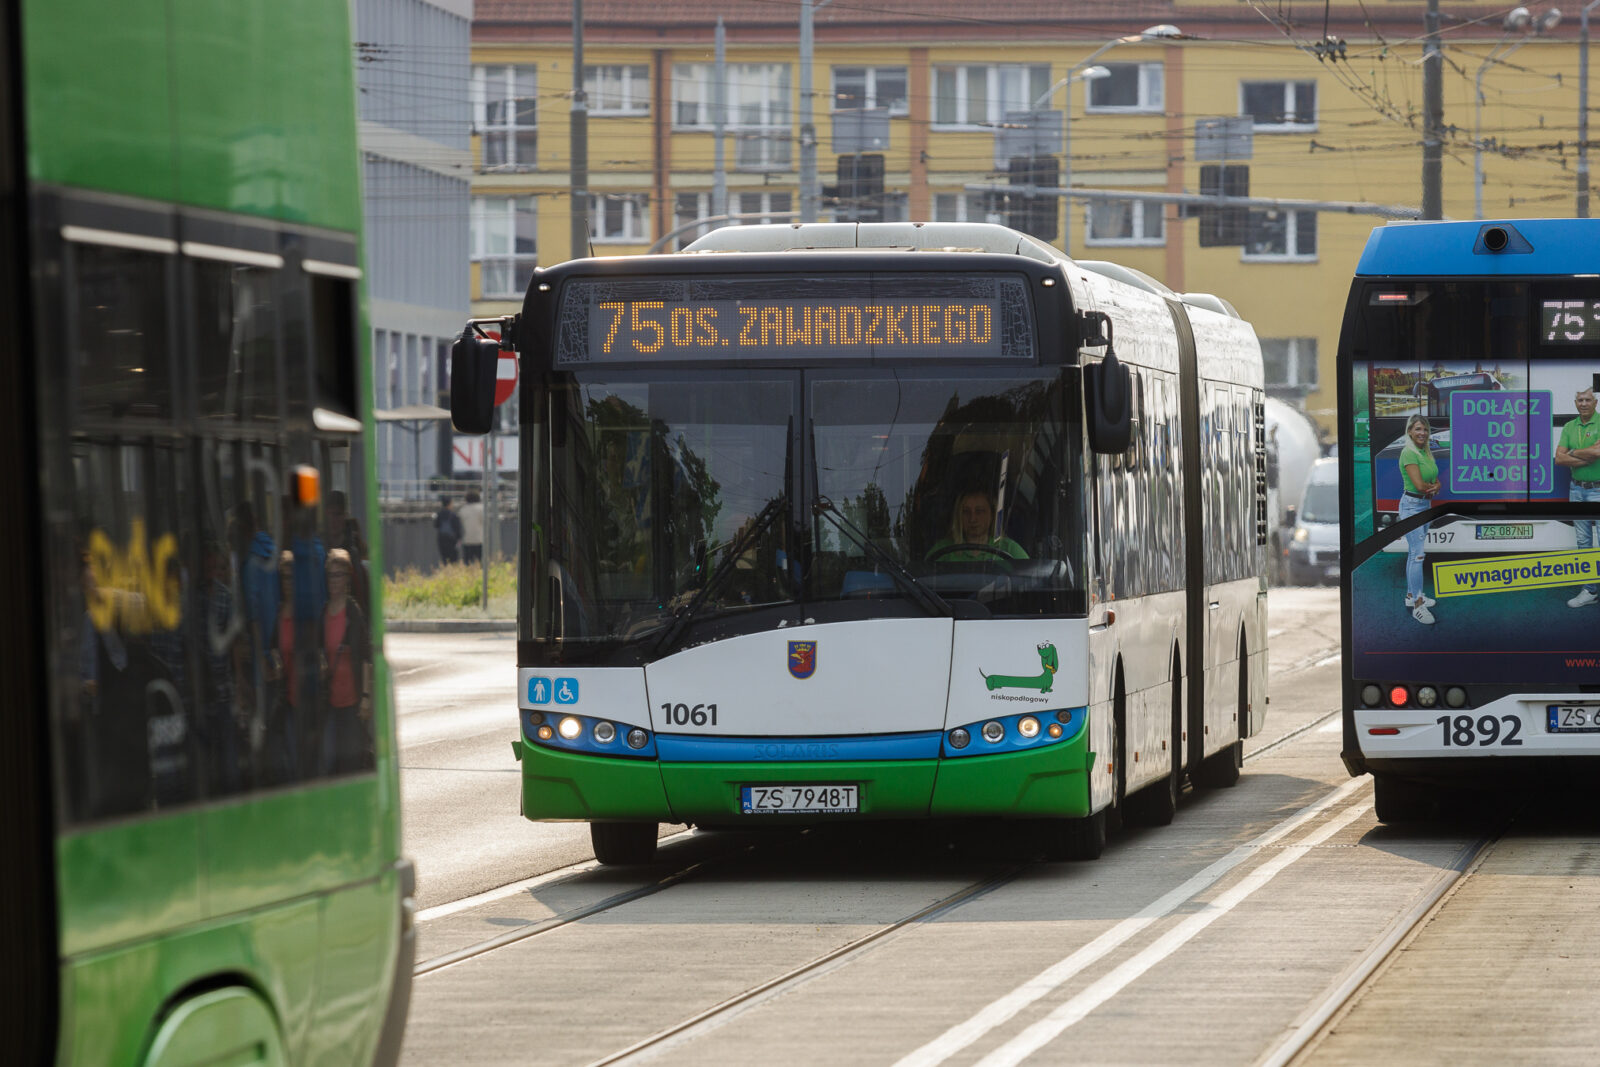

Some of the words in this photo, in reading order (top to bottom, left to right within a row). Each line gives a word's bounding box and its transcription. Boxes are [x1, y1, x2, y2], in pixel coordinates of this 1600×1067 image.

[599, 301, 664, 353] 75
[671, 306, 729, 346] OS.
[739, 304, 992, 346] ZAWADZKIEGO
[1543, 301, 1585, 340] 75
[1463, 399, 1541, 420] DOŁĄCZ
[1487, 421, 1516, 438] DO
[1463, 443, 1541, 460] NASZEJ
[1457, 465, 1527, 482] ZAŁOGI
[1427, 532, 1455, 544] 1197
[1483, 526, 1496, 537] ZS
[1499, 526, 1531, 537] 087NH
[1454, 557, 1591, 588] wynagrodzenie
[991, 693, 1049, 704] niskopodłogowy
[661, 702, 717, 726] 1061
[1562, 708, 1586, 727] ZS
[1436, 714, 1523, 747] 1892
[753, 743, 840, 760] SOLARIS
[754, 789, 784, 809] ZS
[791, 788, 854, 808] 7948T
